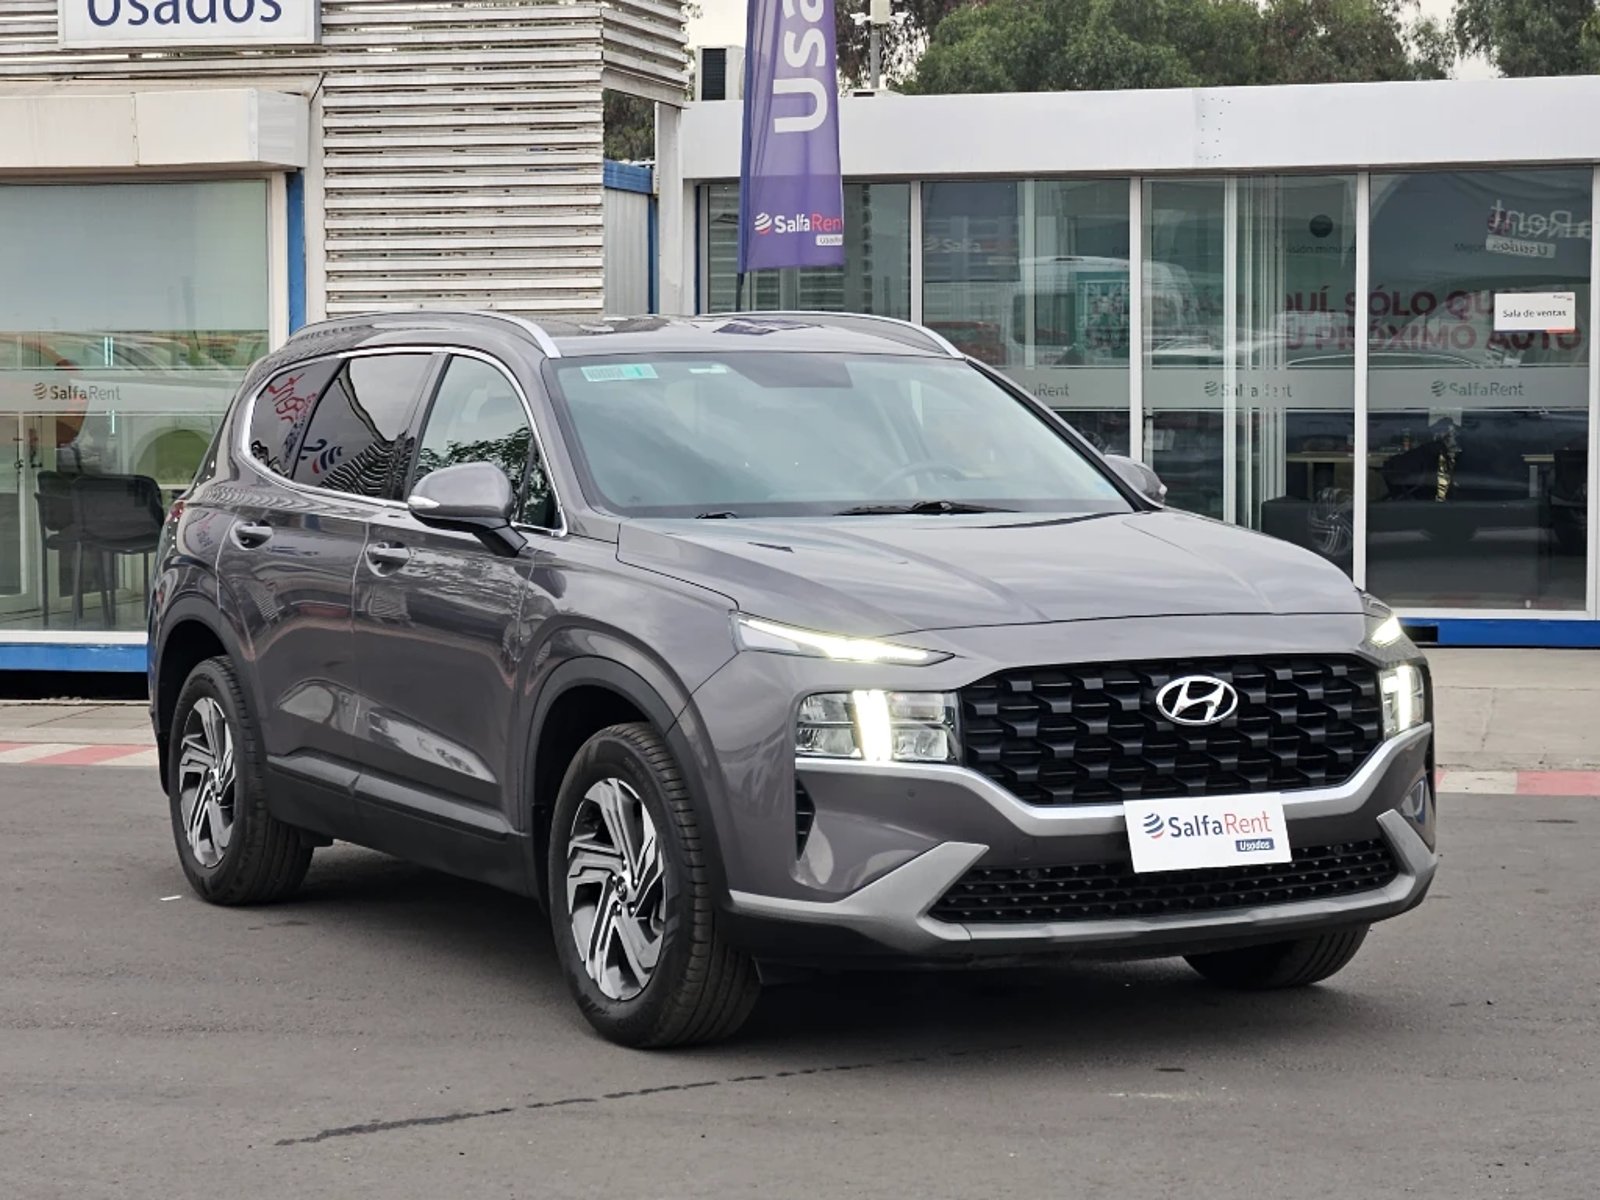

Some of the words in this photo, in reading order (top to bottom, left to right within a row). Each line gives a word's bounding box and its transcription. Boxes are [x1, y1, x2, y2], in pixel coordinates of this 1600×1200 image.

[774, 213, 843, 234] SalfaRen
[1502, 309, 1522, 318] Sala
[1523, 309, 1535, 318] de
[1537, 309, 1567, 318] ventas
[50, 385, 121, 401] SalfaRent
[1449, 381, 1525, 397] SalfaRent
[1168, 811, 1272, 838] SalfaRent
[1240, 840, 1271, 852] Usados
